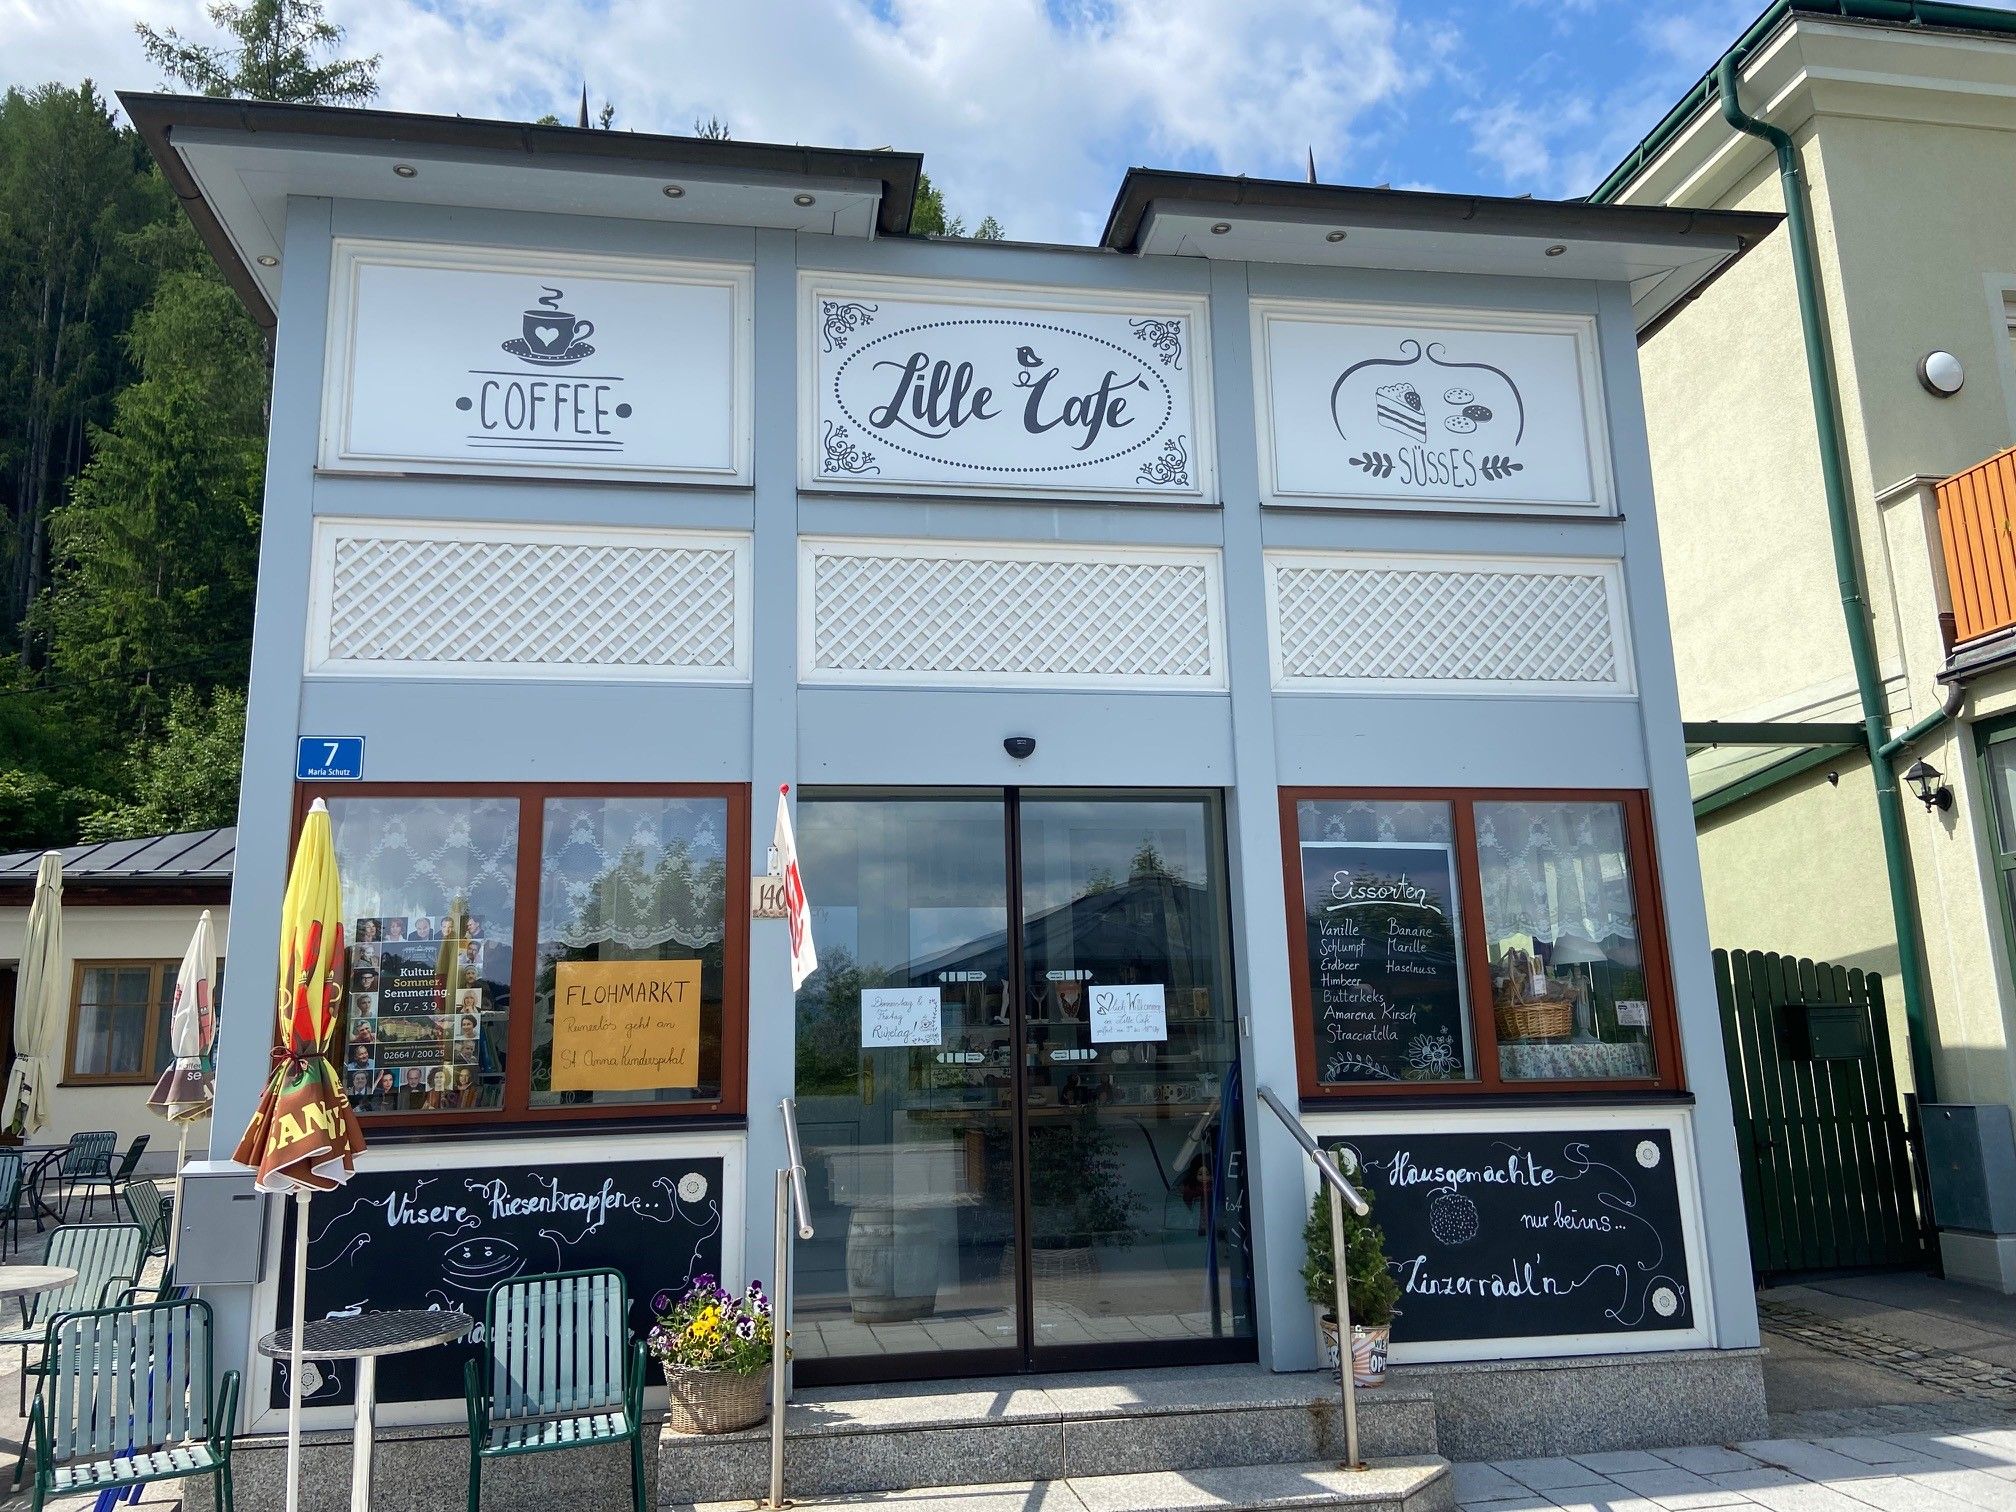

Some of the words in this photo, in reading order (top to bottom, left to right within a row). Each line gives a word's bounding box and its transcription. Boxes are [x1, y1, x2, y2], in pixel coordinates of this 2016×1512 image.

[869, 352, 1002, 439] Lille
[480, 380, 612, 435] COFFEE
[1398, 445, 1477, 488] SÜSSES
[323, 742, 339, 767] 7
[308, 768, 327, 776] Maria
[328, 768, 351, 776] Schutz
[1331, 870, 1428, 909] Eissorten
[1319, 918, 1360, 937] Vanille
[1387, 916, 1434, 938] Banane
[1319, 938, 1366, 958] Schlumpf
[1387, 937, 1428, 956] Marille
[400, 967, 437, 978] Kultur.
[1320, 957, 1360, 972] Erdbeer
[1386, 959, 1437, 975] Haselnuss
[393, 978, 443, 988] Sommer.
[1320, 973, 1362, 988] Himbeer
[384, 988, 451, 999] Semmering.
[566, 980, 691, 1006] FLOHMARKT
[1323, 989, 1385, 1003] Butterkeks
[1323, 1005, 1376, 1021] Amarena
[1380, 1001, 1417, 1025] Kirsch
[624, 1015, 651, 1039] geht
[1326, 1023, 1399, 1044] Stracciatella
[383, 1051, 410, 1060] 02664
[417, 1049, 433, 1058] 200
[583, 1049, 619, 1068] Anna
[620, 1044, 685, 1072] Kinderspital
[1386, 1150, 1558, 1193] Hausgemachte
[382, 1190, 470, 1227] Unsere
[1520, 1213, 1549, 1230] nur
